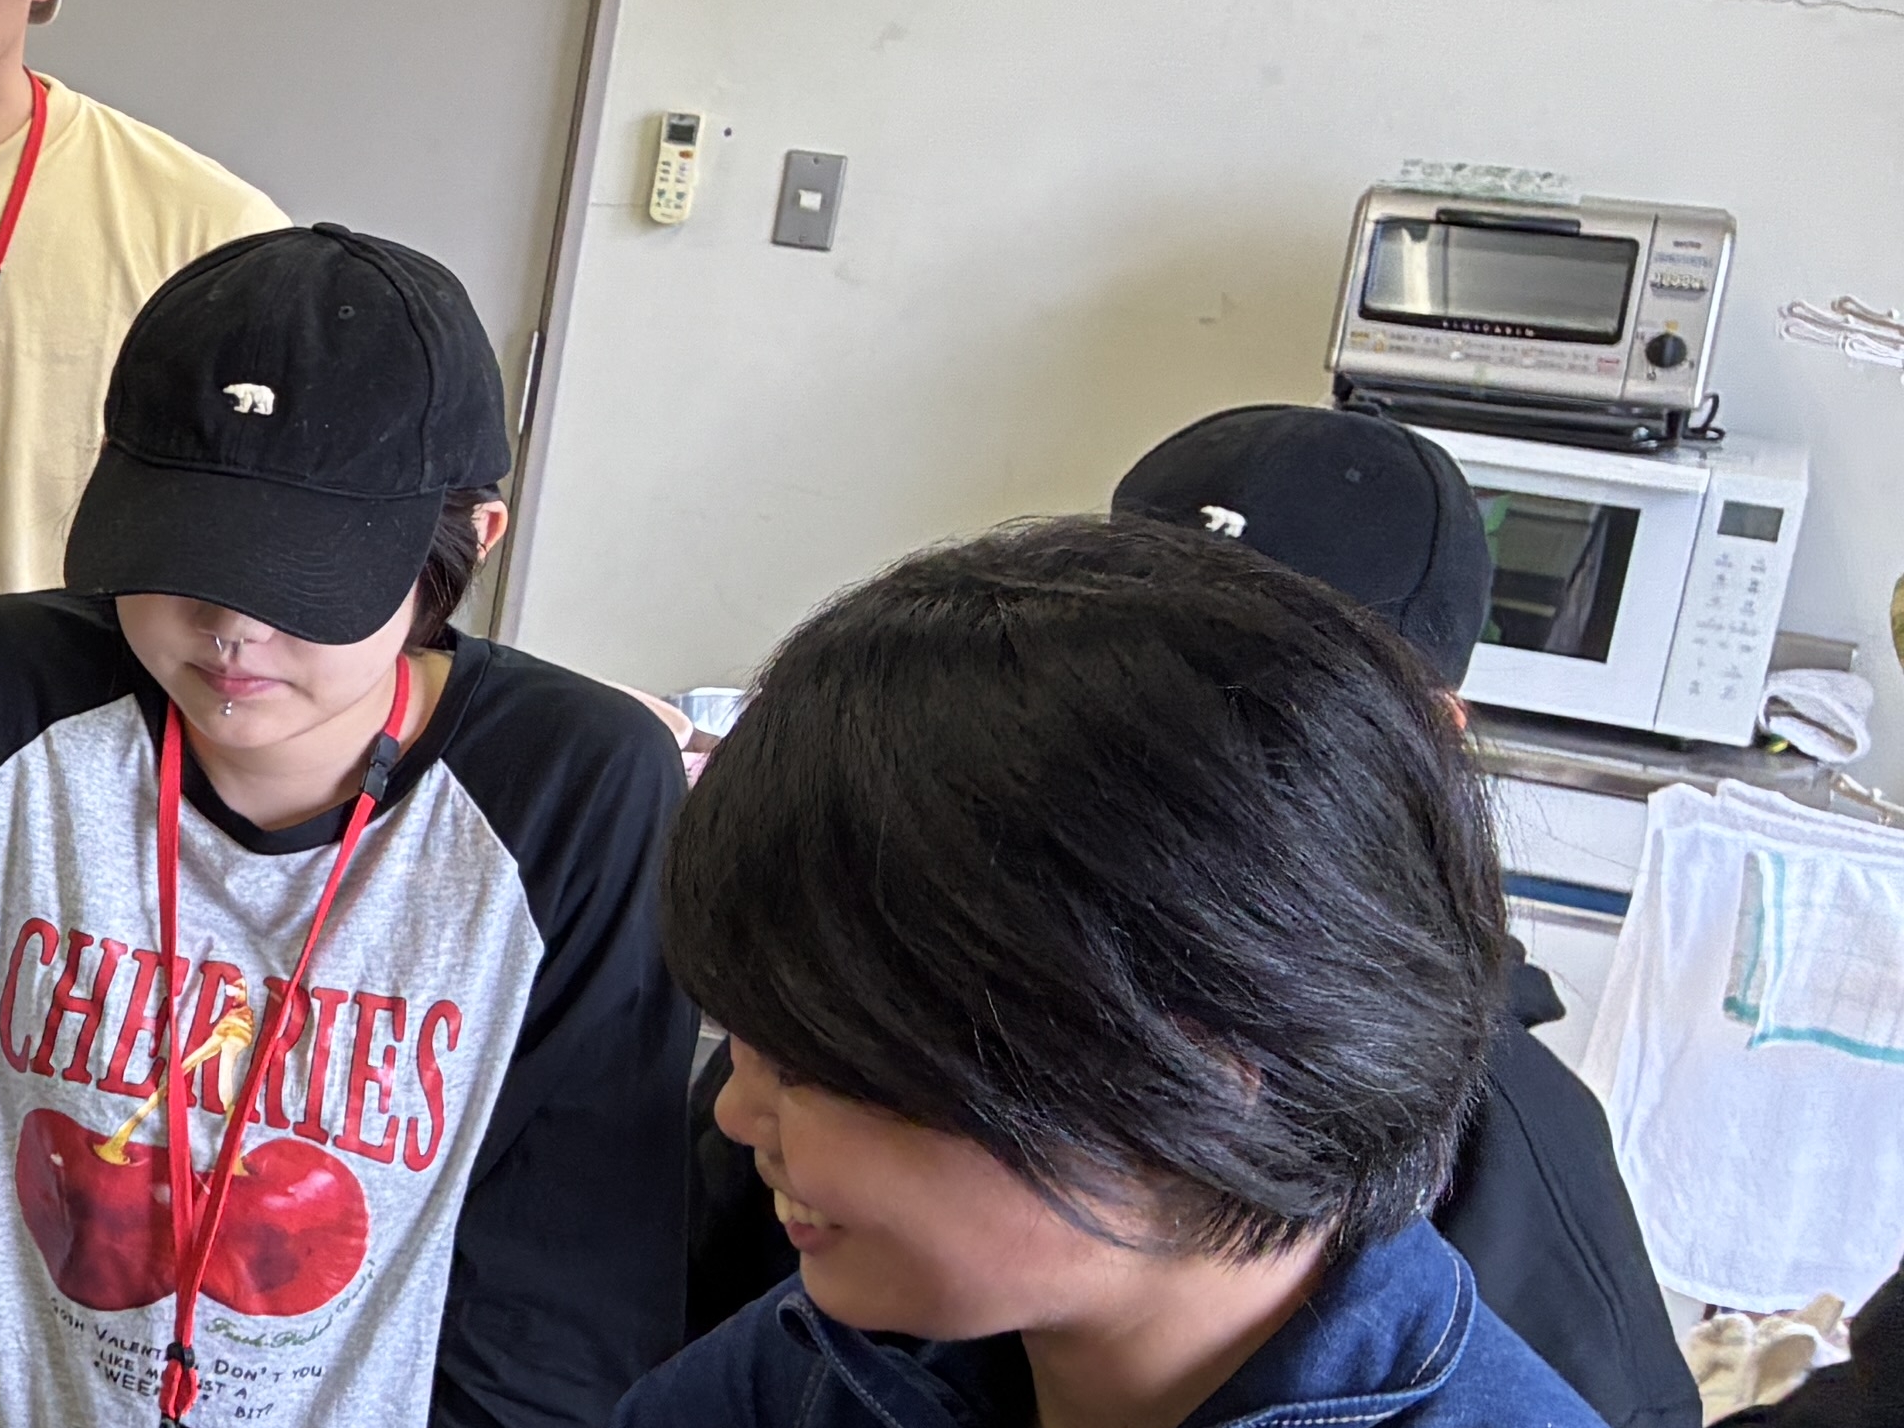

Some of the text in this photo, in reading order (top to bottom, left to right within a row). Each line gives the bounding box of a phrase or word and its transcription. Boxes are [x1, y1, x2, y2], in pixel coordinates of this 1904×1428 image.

[99, 1350, 135, 1371] LIKE
[234, 1388, 248, 1400] A
[292, 1365, 323, 1380] YOU
